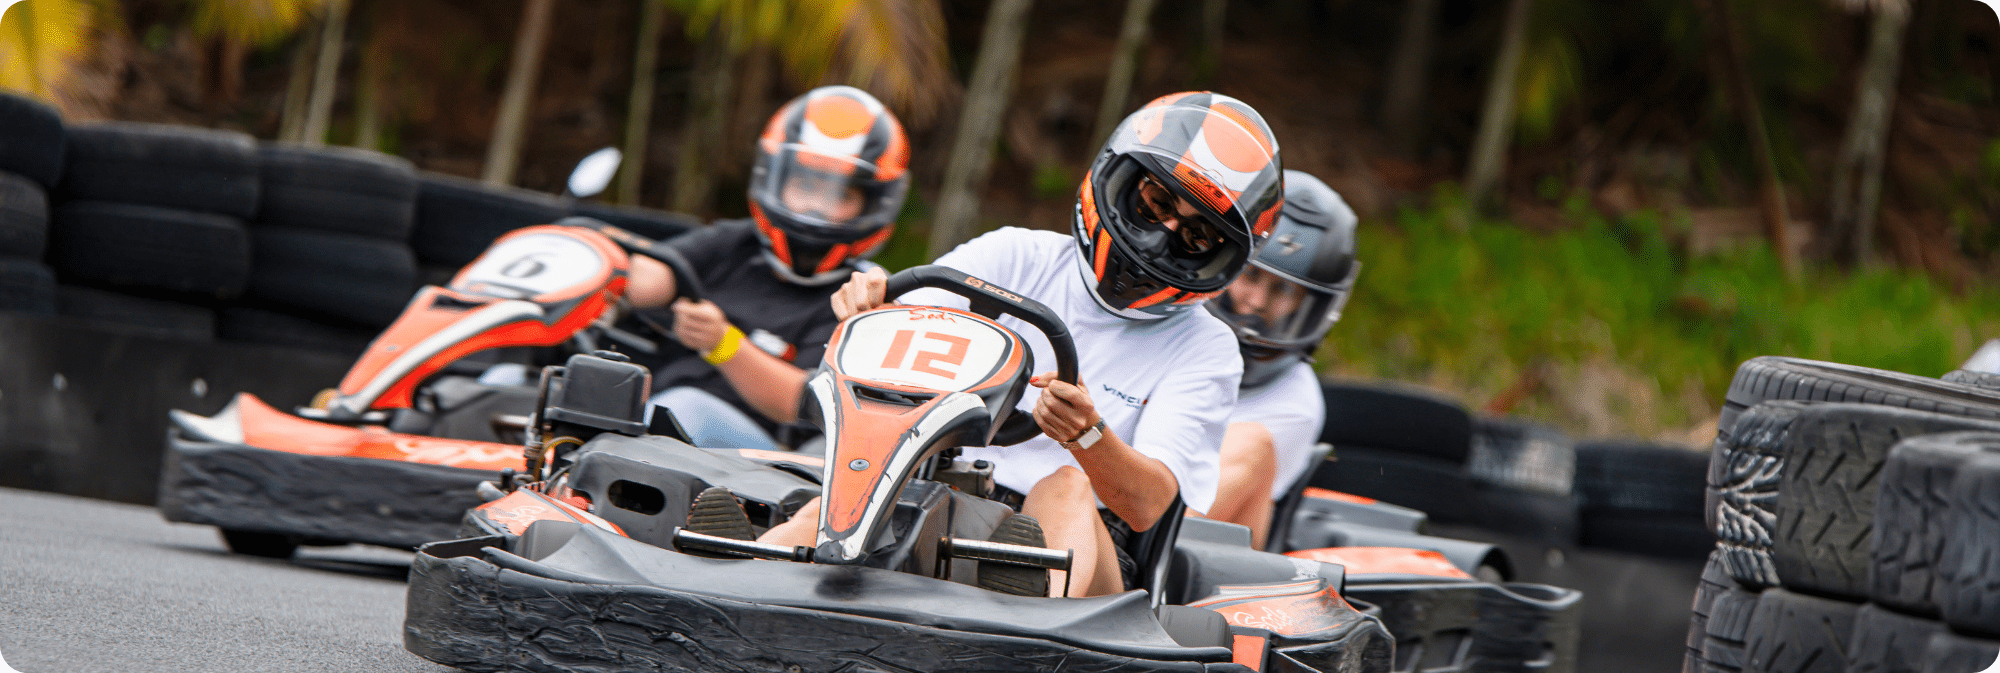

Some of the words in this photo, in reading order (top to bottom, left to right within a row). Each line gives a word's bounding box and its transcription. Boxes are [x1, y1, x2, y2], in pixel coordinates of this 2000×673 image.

[499, 252, 556, 279] 6
[984, 284, 1024, 303] SODI
[909, 307, 958, 324] Sodi
[880, 329, 972, 381] 12
